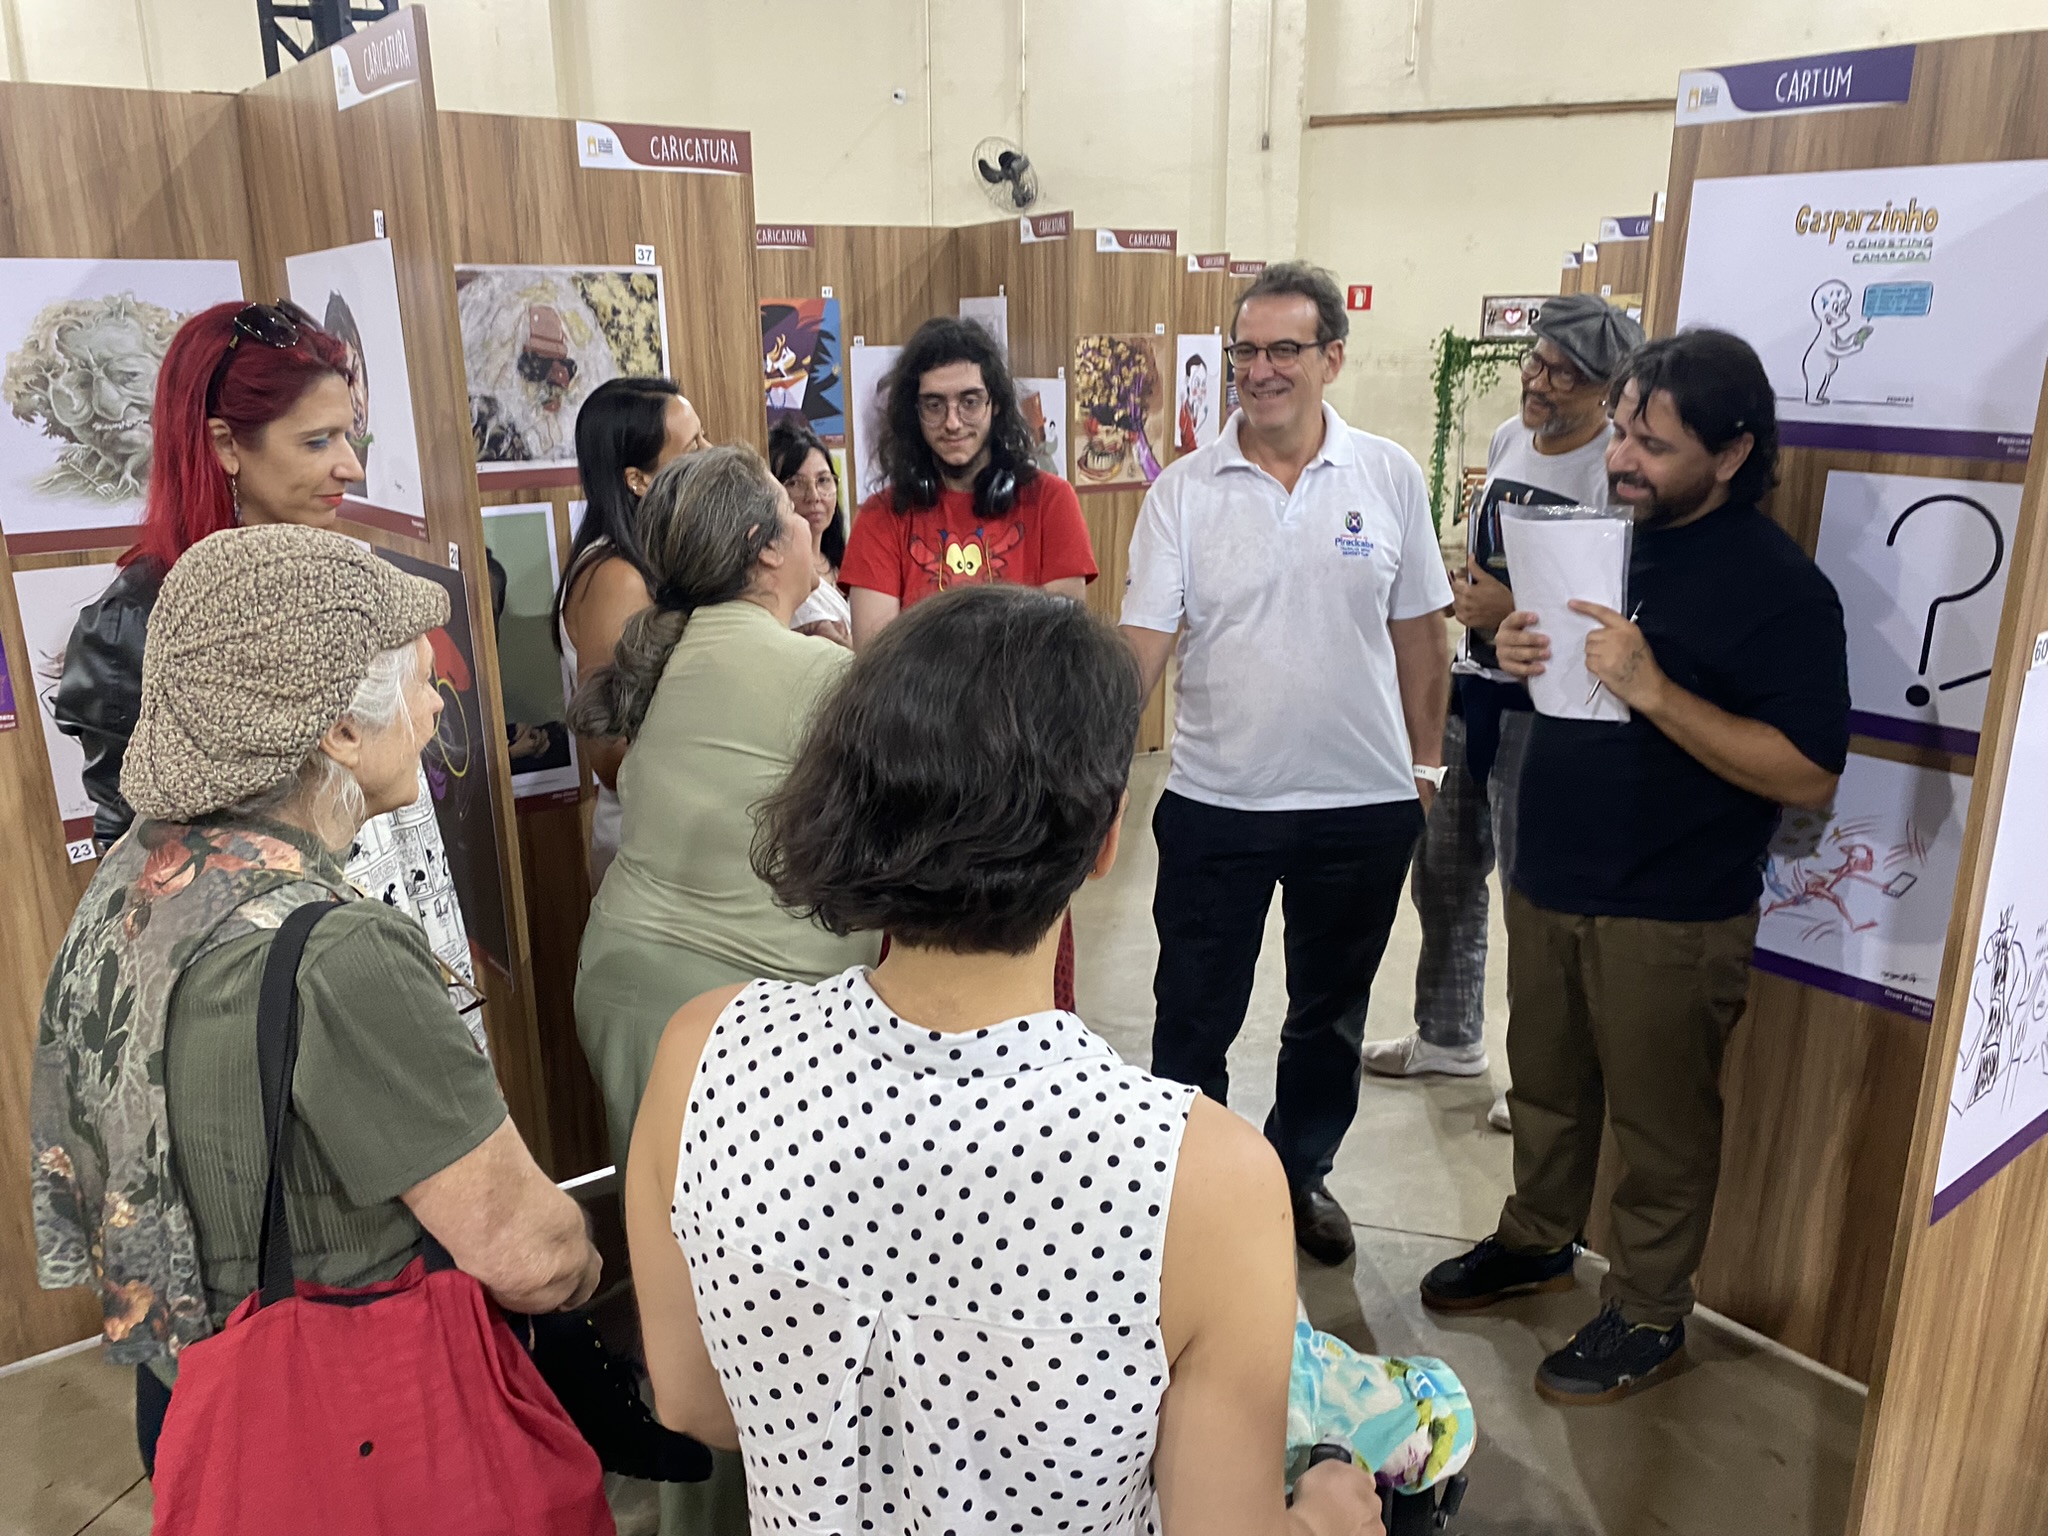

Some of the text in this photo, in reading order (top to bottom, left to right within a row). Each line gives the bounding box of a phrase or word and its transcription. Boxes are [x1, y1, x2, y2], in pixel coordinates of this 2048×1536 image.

[363, 28, 411, 82] CARICATURA
[1775, 64, 1854, 103] CARTUM
[650, 134, 739, 166] CARICATURA
[1039, 216, 1066, 234] CARICATURA
[1795, 196, 1939, 246] Gasparzinho
[756, 228, 807, 244] CARICATURA
[1129, 233, 1171, 248] CARICATURA
[1858, 236, 1934, 250] GHOSTING
[637, 249, 652, 261] 37
[70, 843, 92, 859] 23
